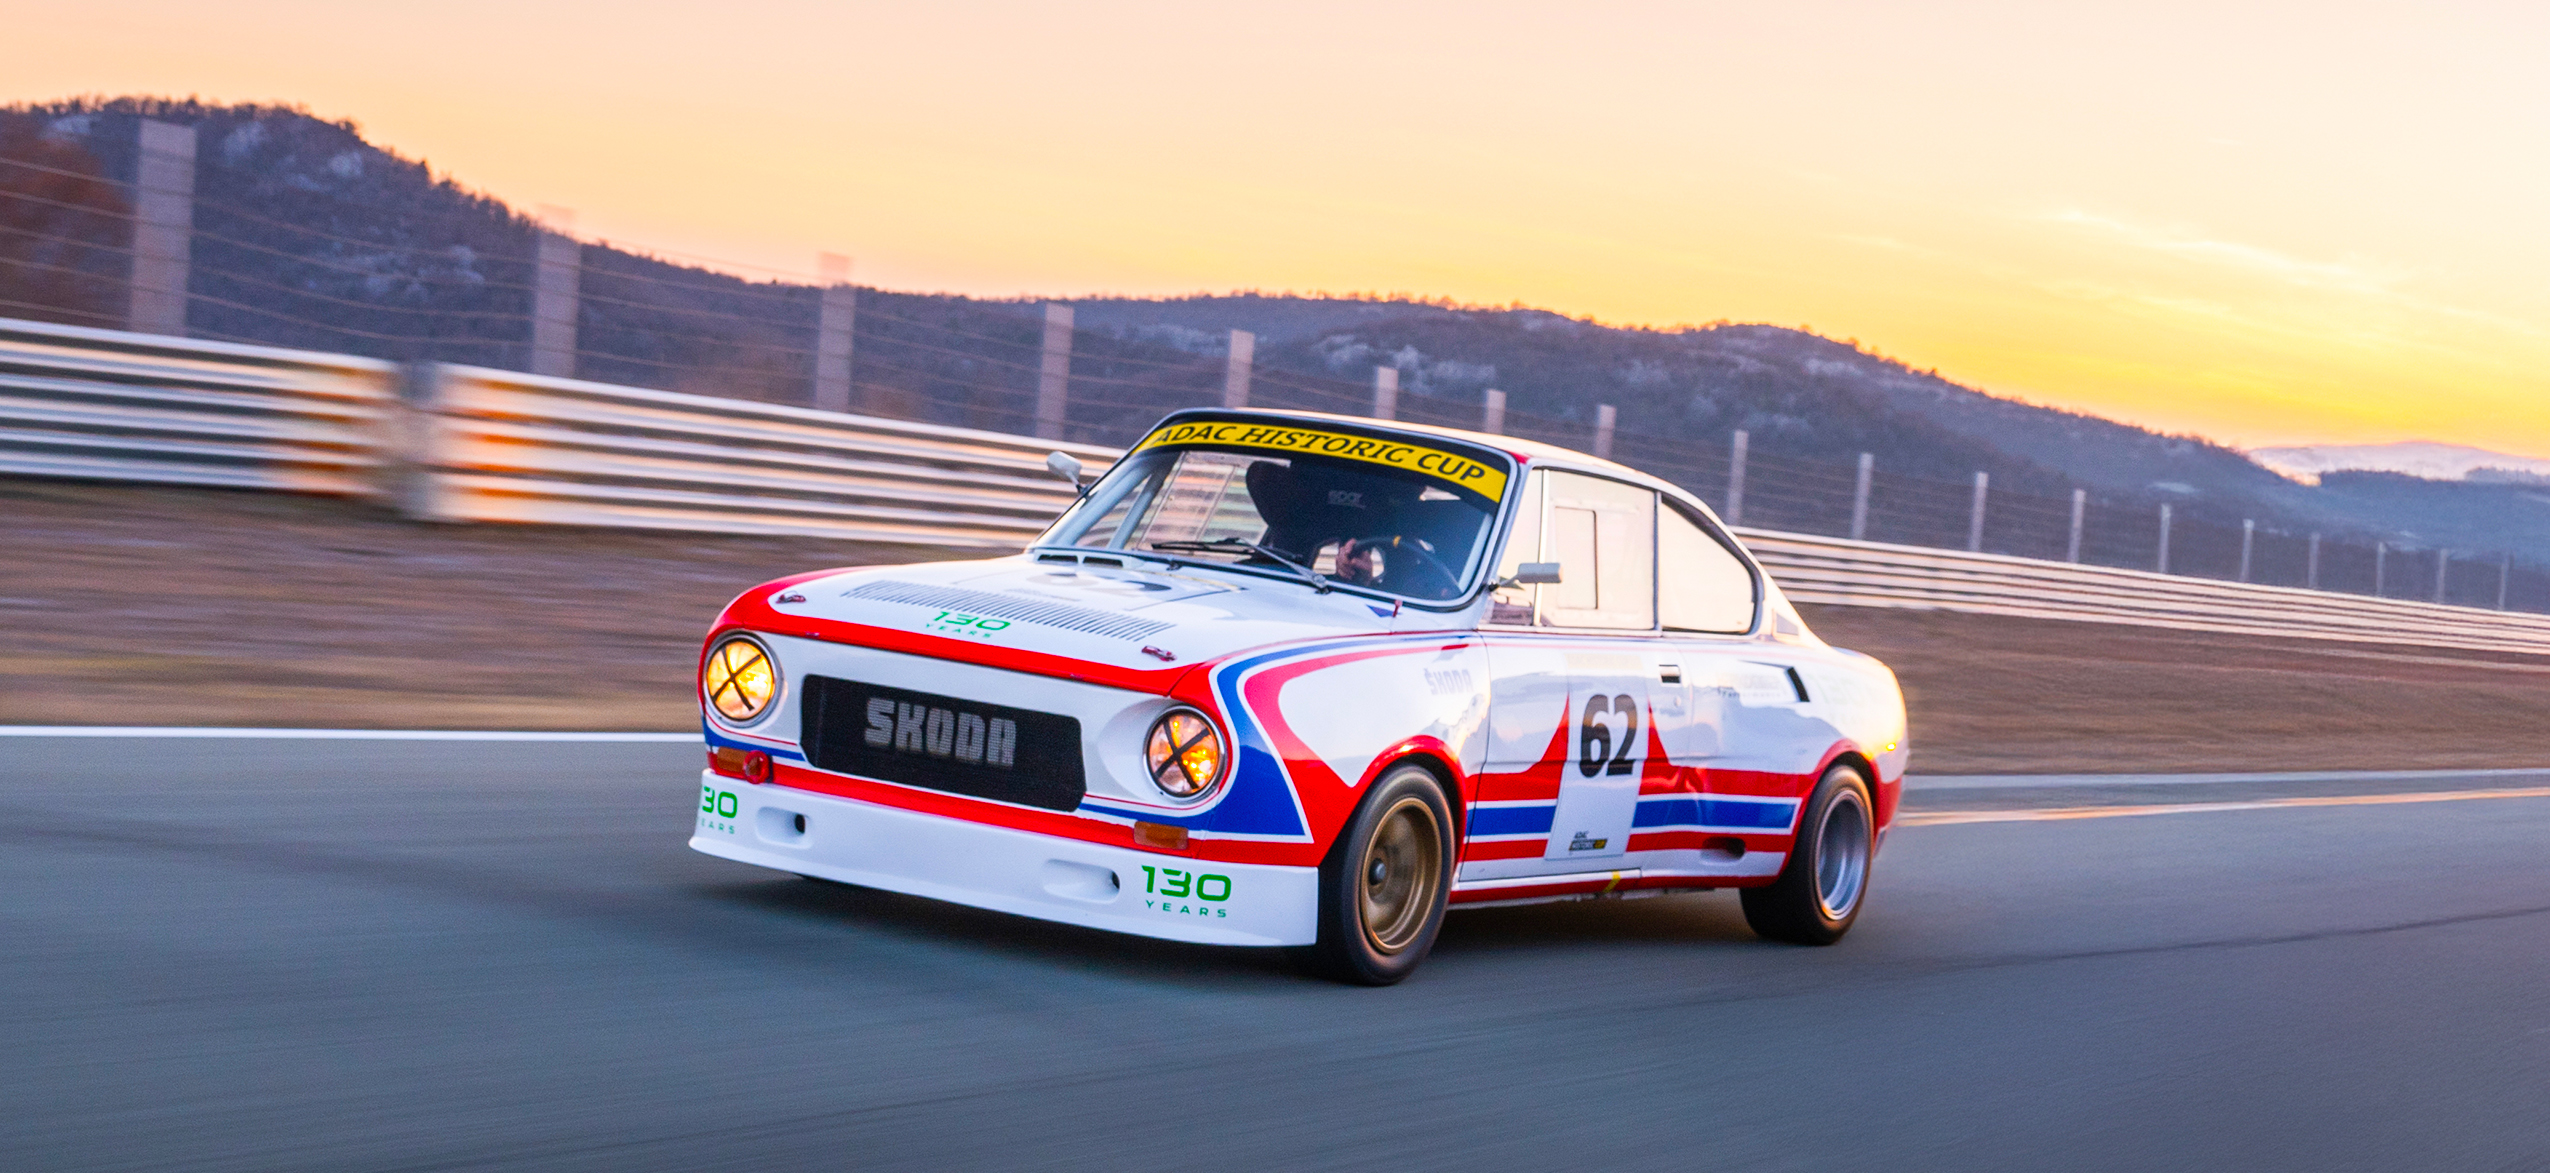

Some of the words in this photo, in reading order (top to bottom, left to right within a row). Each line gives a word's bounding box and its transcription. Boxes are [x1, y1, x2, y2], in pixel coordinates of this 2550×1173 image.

[1154, 425, 1236, 443] ADAC
[1235, 427, 1414, 464] HISTORIC
[1417, 453, 1485, 481] CUP
[933, 610, 1011, 631] 130
[864, 696, 1017, 768] SKODA
[1578, 694, 1638, 778] 62
[701, 785, 738, 819] 30
[701, 817, 736, 835] EARS
[1140, 864, 1232, 902] 130
[1145, 899, 1227, 918] YEARS
